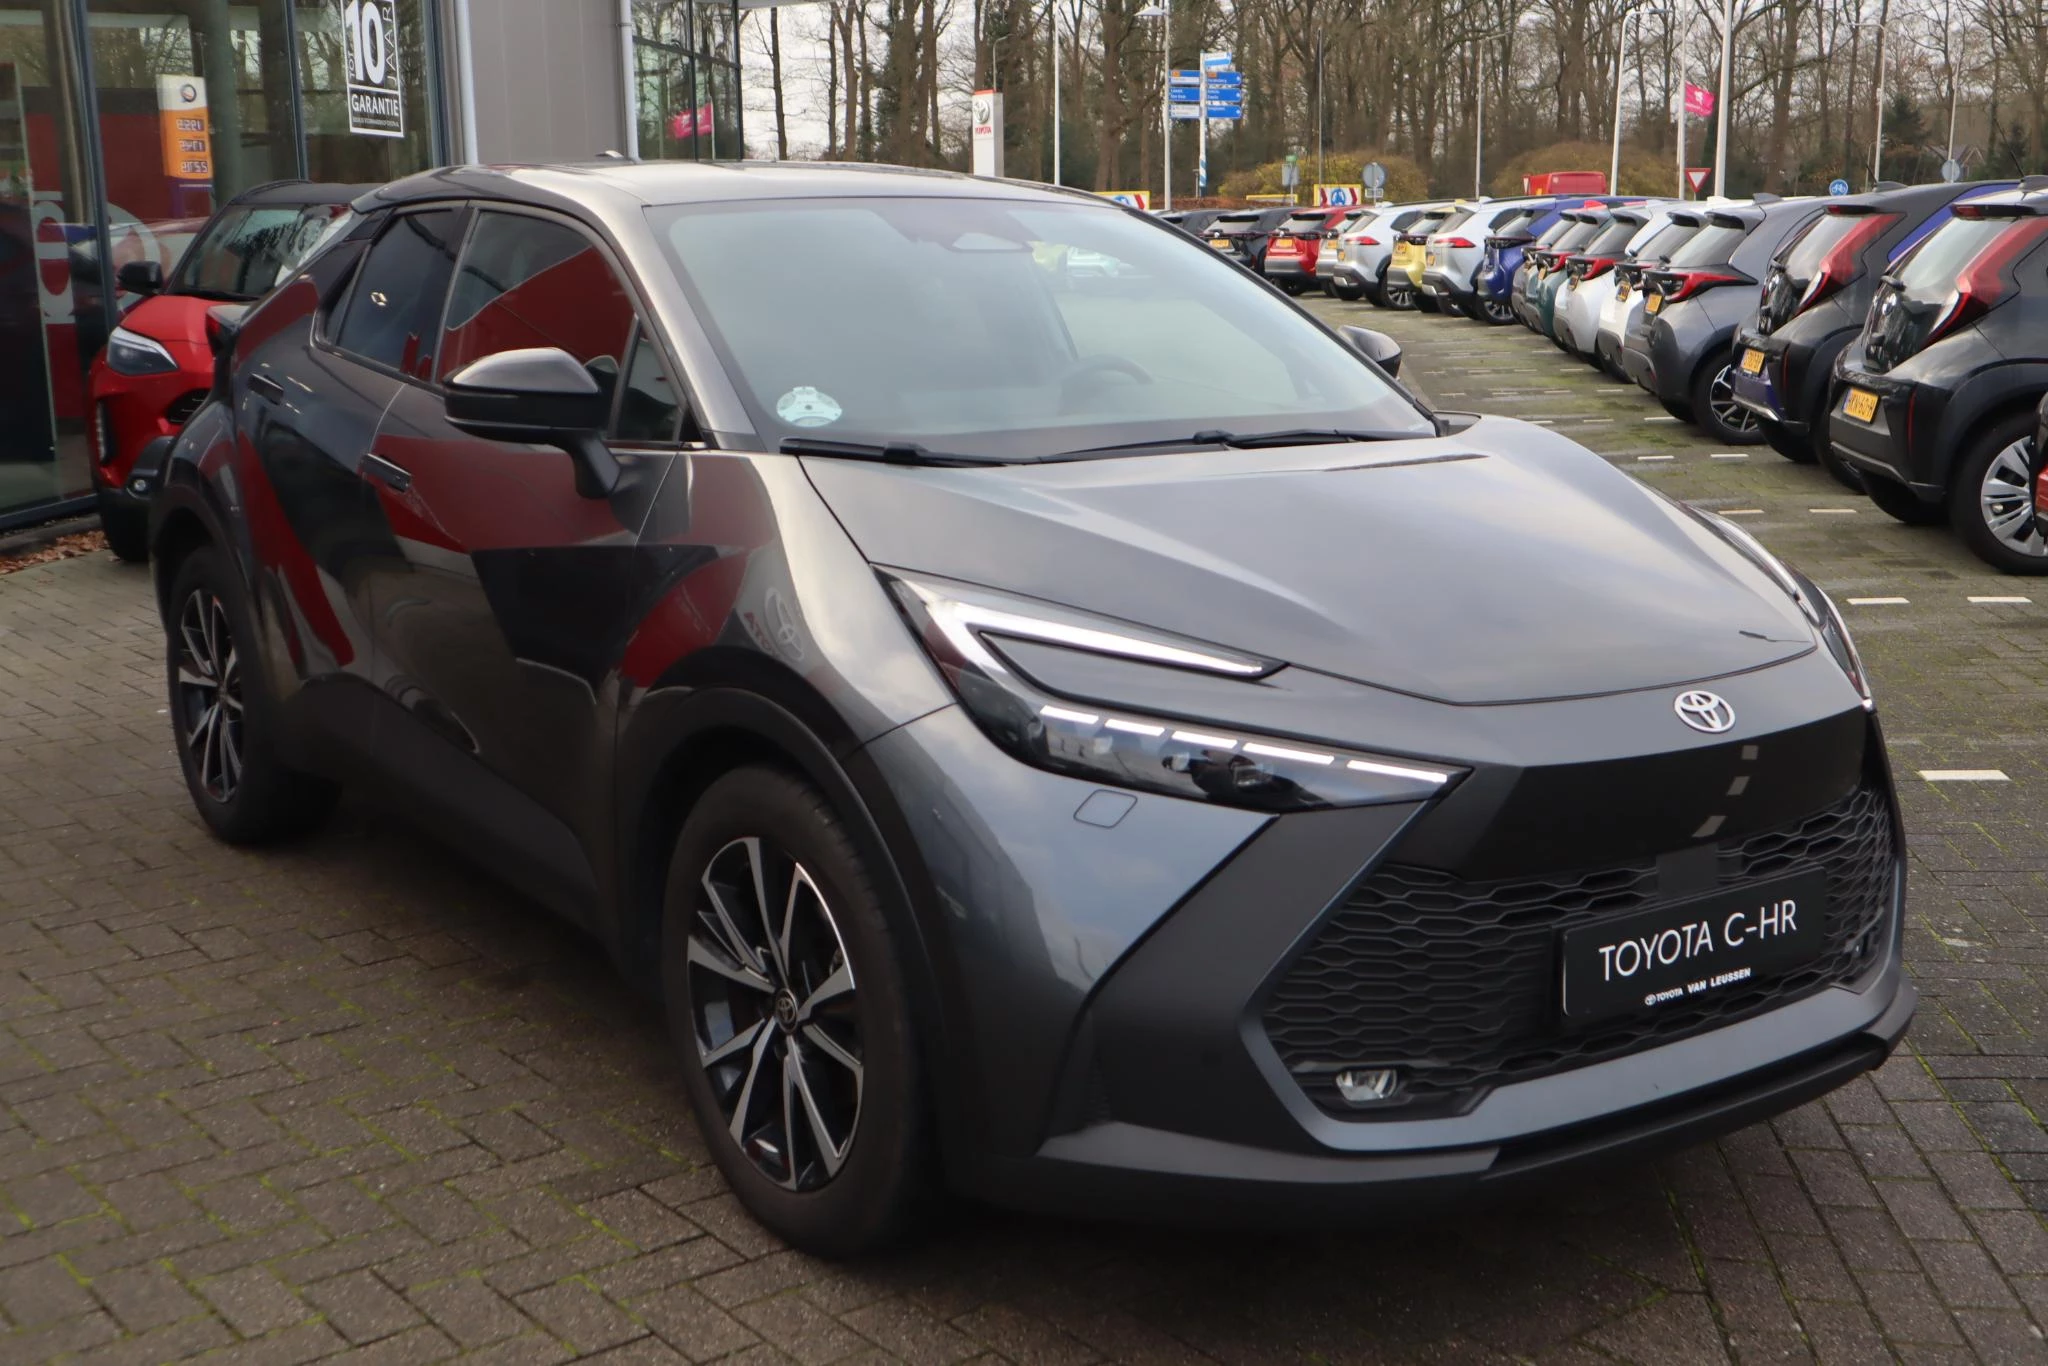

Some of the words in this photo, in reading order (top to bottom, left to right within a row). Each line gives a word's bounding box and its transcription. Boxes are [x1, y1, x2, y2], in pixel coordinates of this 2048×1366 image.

[345, 0, 386, 84] 10
[383, 6, 397, 84] JAAR
[351, 94, 399, 117] GARANTIE
[1598, 920, 1714, 982] TOYOTA
[1724, 899, 1797, 948] C-HR
[1656, 987, 1683, 1002] TOYOTA
[1687, 979, 1707, 994] VAN
[1710, 967, 1751, 987] LEUSSEN
